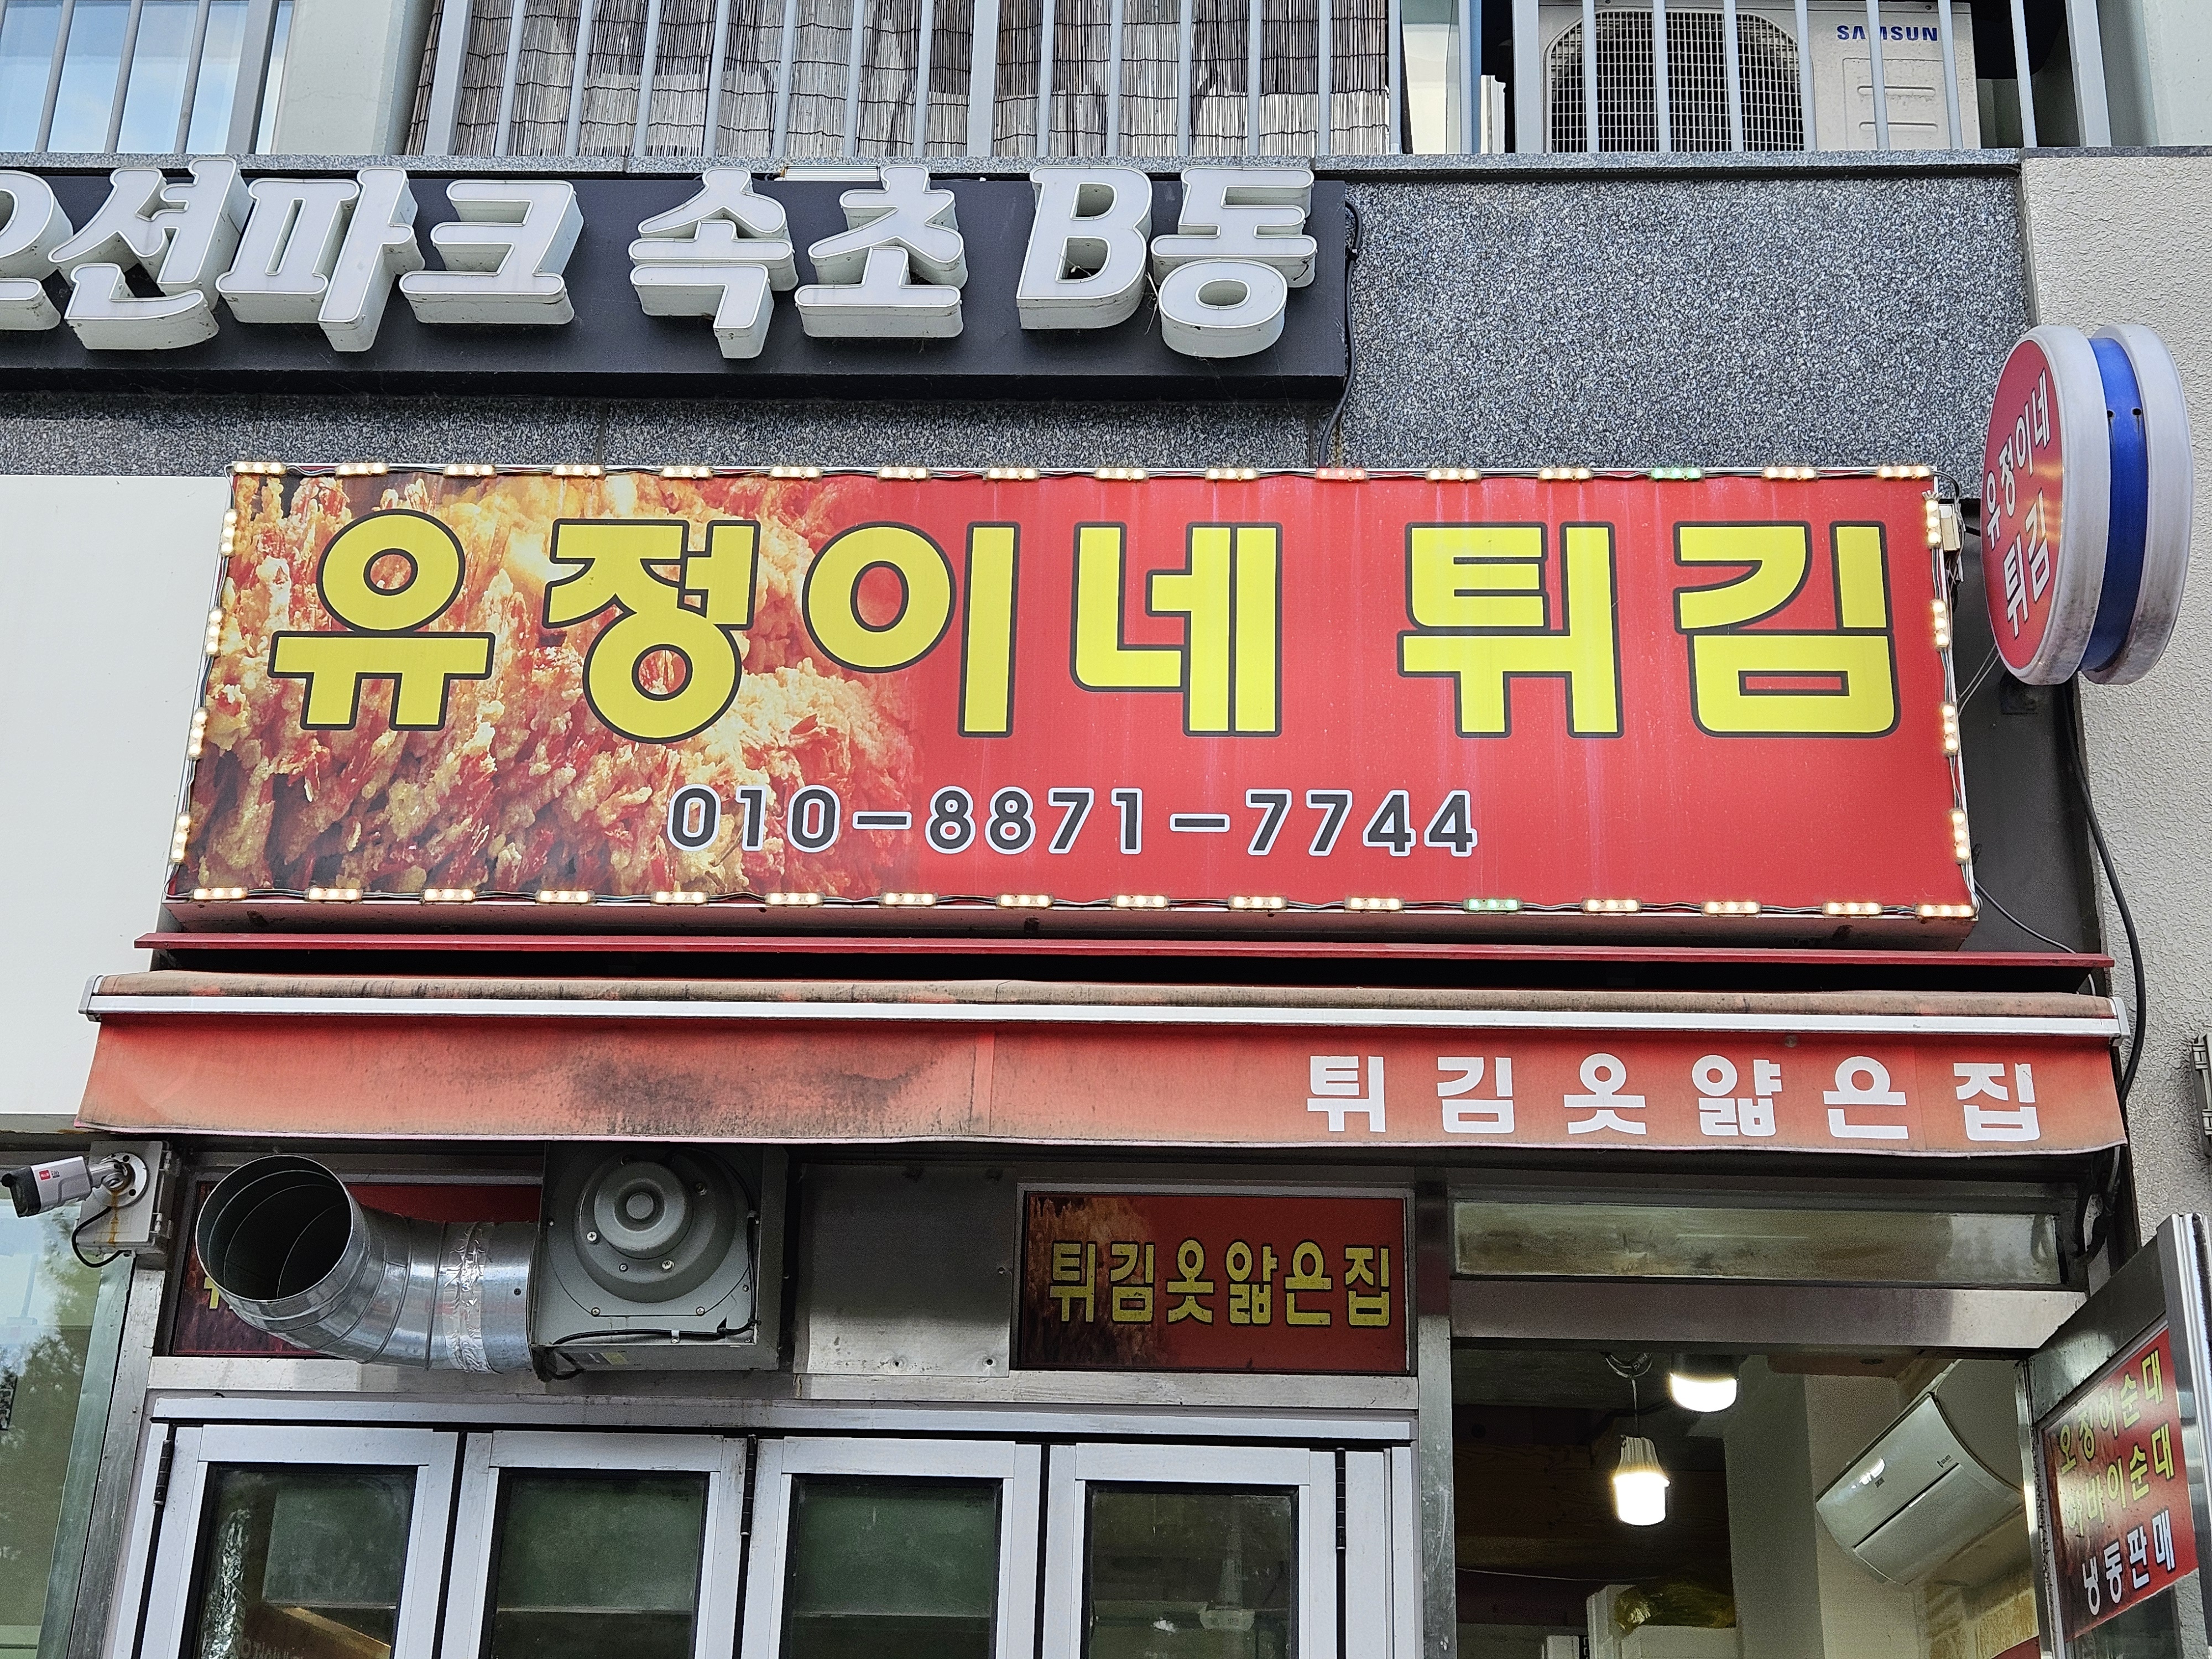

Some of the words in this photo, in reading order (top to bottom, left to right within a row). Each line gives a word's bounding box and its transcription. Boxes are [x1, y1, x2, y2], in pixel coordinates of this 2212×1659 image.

[1837, 25, 1938, 41] SASUN
[628, 164, 968, 358] 속초
[1986, 367, 2051, 551] 유정이네
[267, 508, 1283, 744] 유정이네
[1397, 521, 1900, 738] 튀김
[2003, 489, 2051, 640] 튀김
[667, 784, 1478, 857] 010-8871-7744
[2059, 1348, 2164, 1475] 오징어순대
[2066, 1422, 2174, 1537] 아바이순대
[2081, 1509, 2176, 1615] 냉동판매
